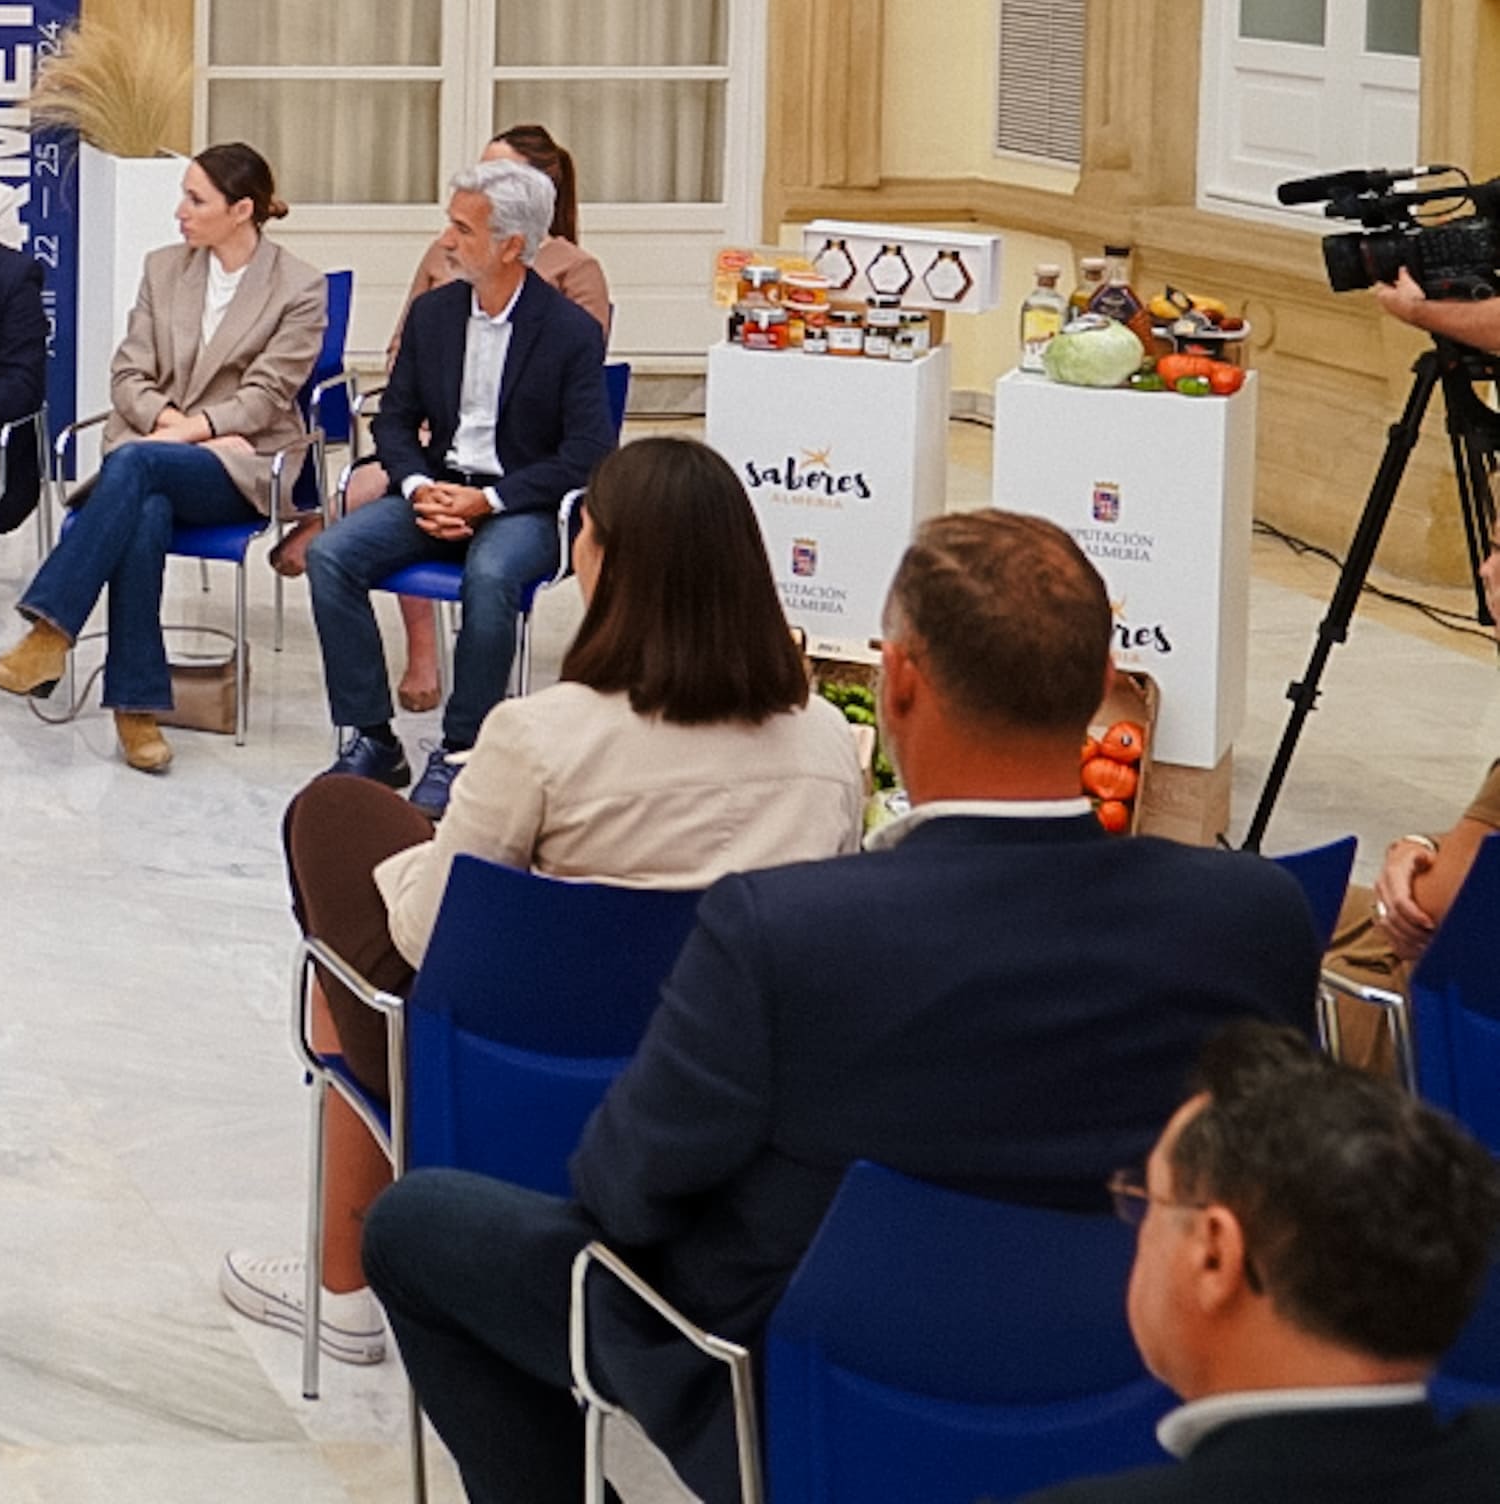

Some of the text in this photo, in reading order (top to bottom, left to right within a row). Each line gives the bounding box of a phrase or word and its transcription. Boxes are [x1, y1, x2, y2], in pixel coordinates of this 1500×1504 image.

[34, 143, 59, 177] 25
[34, 236, 59, 268] 22
[1073, 528, 1153, 547] PUTACIÓN
